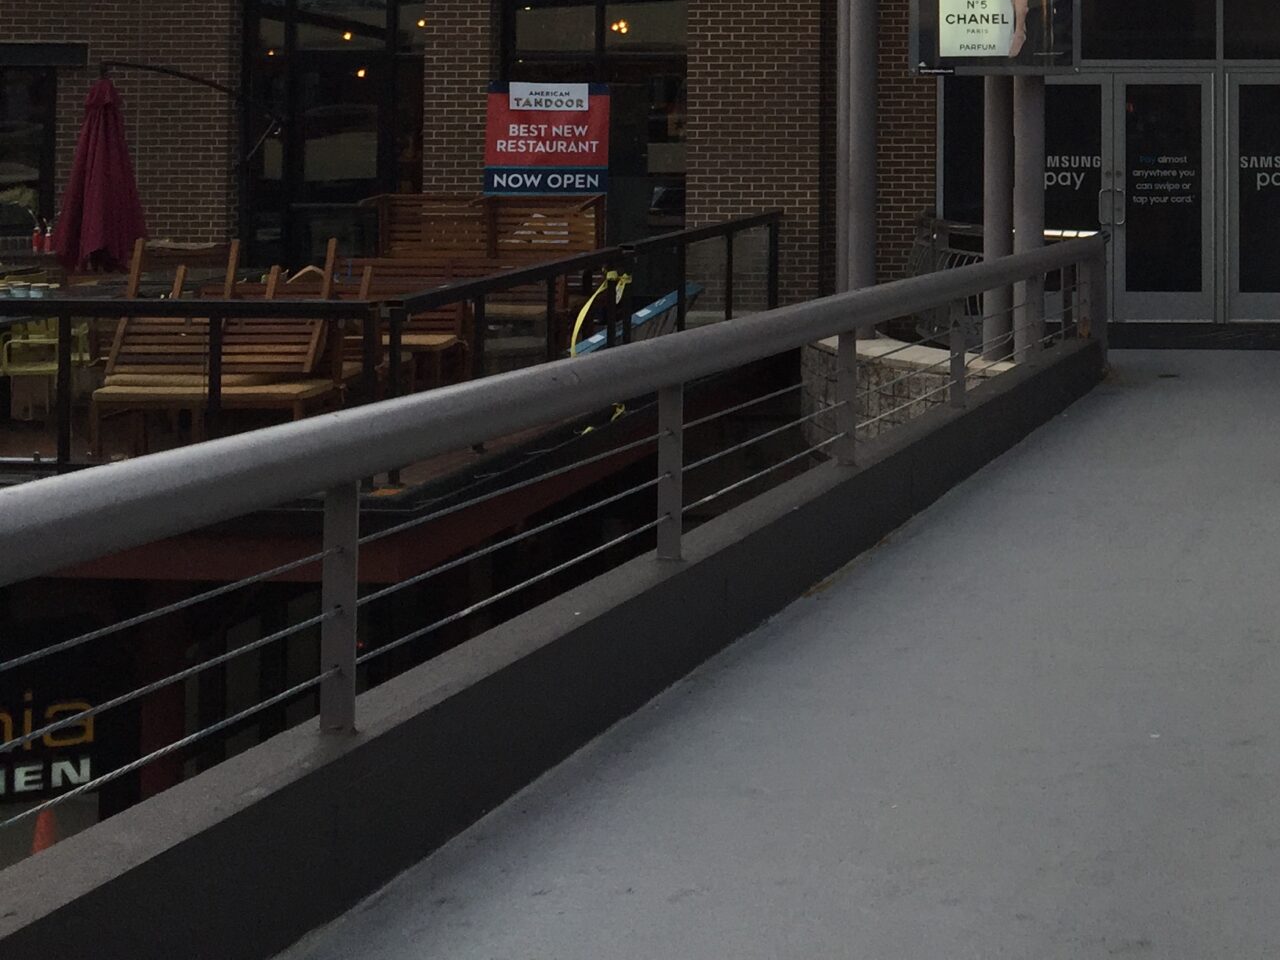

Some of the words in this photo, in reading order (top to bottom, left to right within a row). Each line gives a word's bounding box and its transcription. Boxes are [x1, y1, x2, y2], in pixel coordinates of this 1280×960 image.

[945, 13, 1009, 25] CHANEL
[959, 43, 996, 51] PARFUM
[513, 97, 584, 109] TANDOOR
[508, 124, 548, 137] BEST
[551, 124, 588, 137] NEW
[496, 140, 600, 153] RESTAURANT
[1047, 155, 1101, 168] MSUNG
[1044, 171, 1085, 190] pay
[1179, 169, 1195, 179] you
[493, 173, 544, 188] NOW
[546, 173, 599, 189] OPEN
[0, 757, 91, 795] EN
